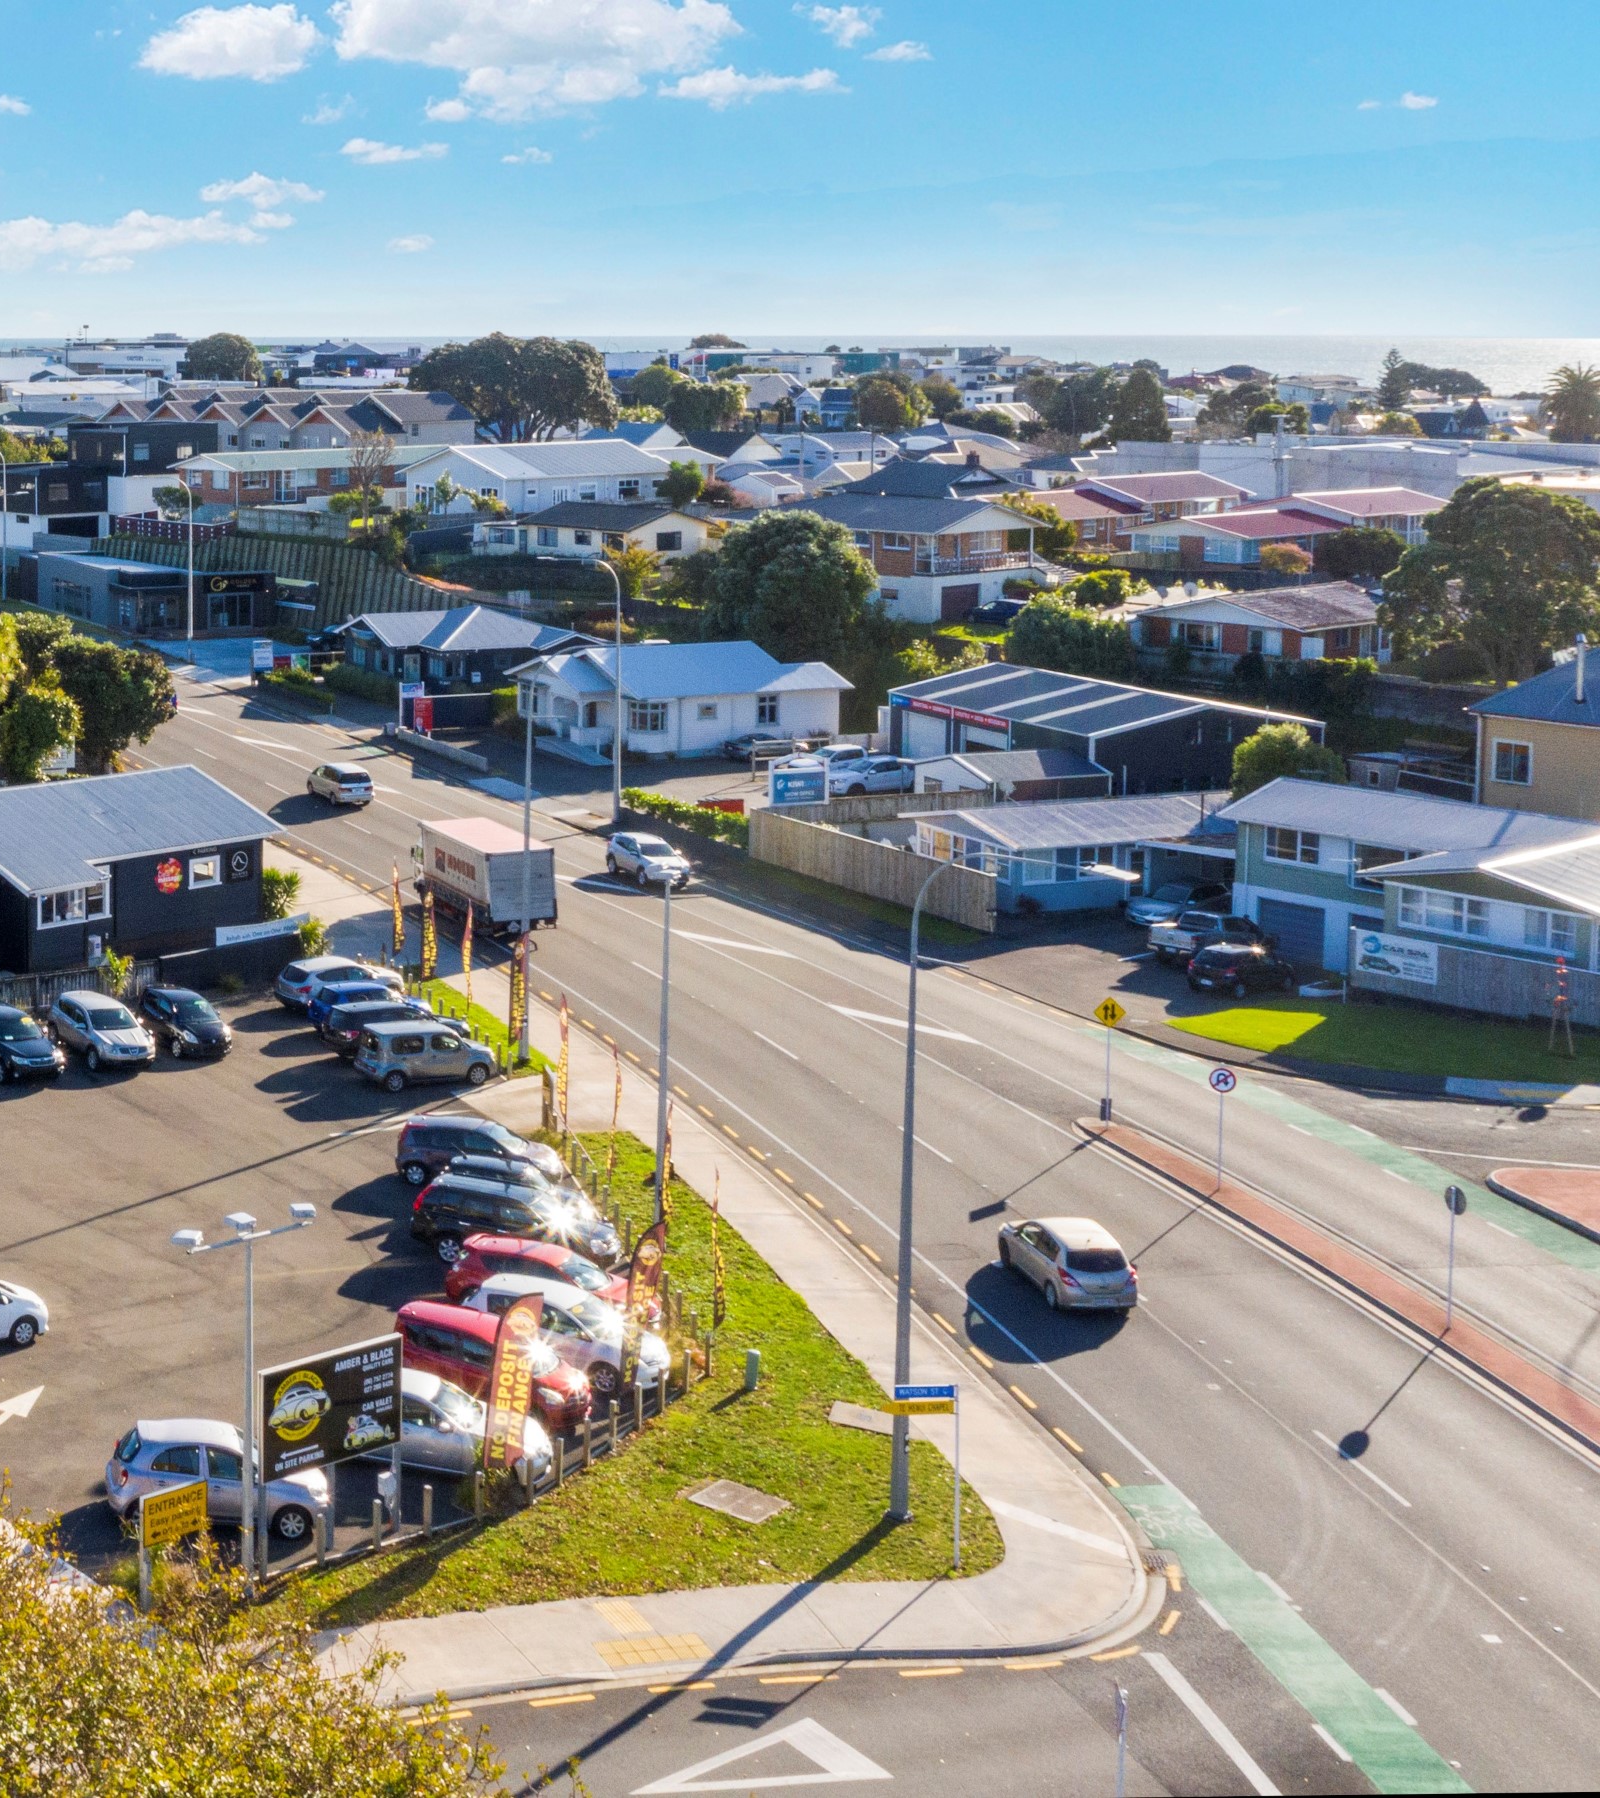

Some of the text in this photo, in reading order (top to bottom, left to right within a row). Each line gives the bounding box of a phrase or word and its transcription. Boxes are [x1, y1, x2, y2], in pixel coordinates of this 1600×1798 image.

[1382, 944, 1404, 953] CAR
[1407, 949, 1429, 958] SPA
[335, 1347, 394, 1373] AMBER & BLACK
[362, 1358, 394, 1372] QUALITY CARS
[278, 1373, 319, 1396] AMBER BLACK
[362, 1396, 393, 1412] CAR VALET
[491, 1340, 519, 1460] NO DEPOSIT
[507, 1358, 533, 1448] FINANCE
[928, 1402, 950, 1411] CHAPEL
[275, 1450, 324, 1472] ON SITE PARKING
[148, 1489, 203, 1515] ENTRANCE
[150, 1516, 170, 1528] Easy
